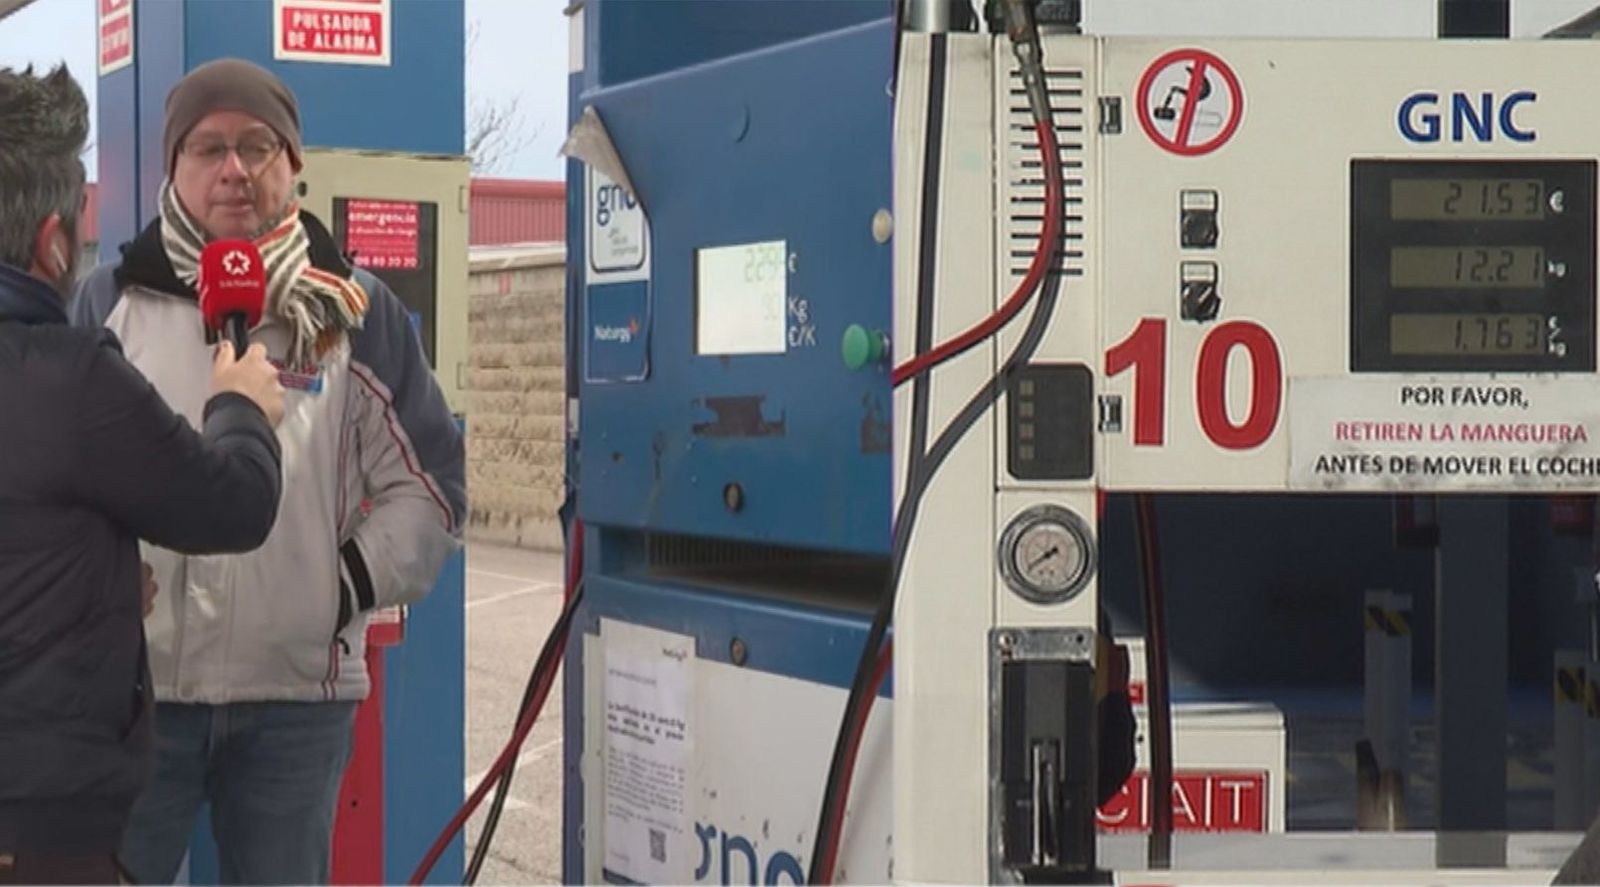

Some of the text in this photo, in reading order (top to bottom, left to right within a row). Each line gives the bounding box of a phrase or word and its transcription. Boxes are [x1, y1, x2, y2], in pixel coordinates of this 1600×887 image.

[292, 11, 371, 32] PULSADOR
[287, 31, 377, 53] DE ALARMA
[1398, 92, 1537, 143] GNC
[1443, 183, 1541, 216] 21.53
[1455, 251, 1541, 283] 12.21
[1105, 318, 1282, 450] 10
[1401, 387, 1529, 410] POR FAVOR,
[1336, 422, 1588, 443] RETIREN LA MANGUERA
[1315, 454, 1383, 474] ANTES
[1390, 455, 1417, 475] DE
[1423, 456, 1502, 476] MOVER
[1509, 456, 1531, 476] EL
